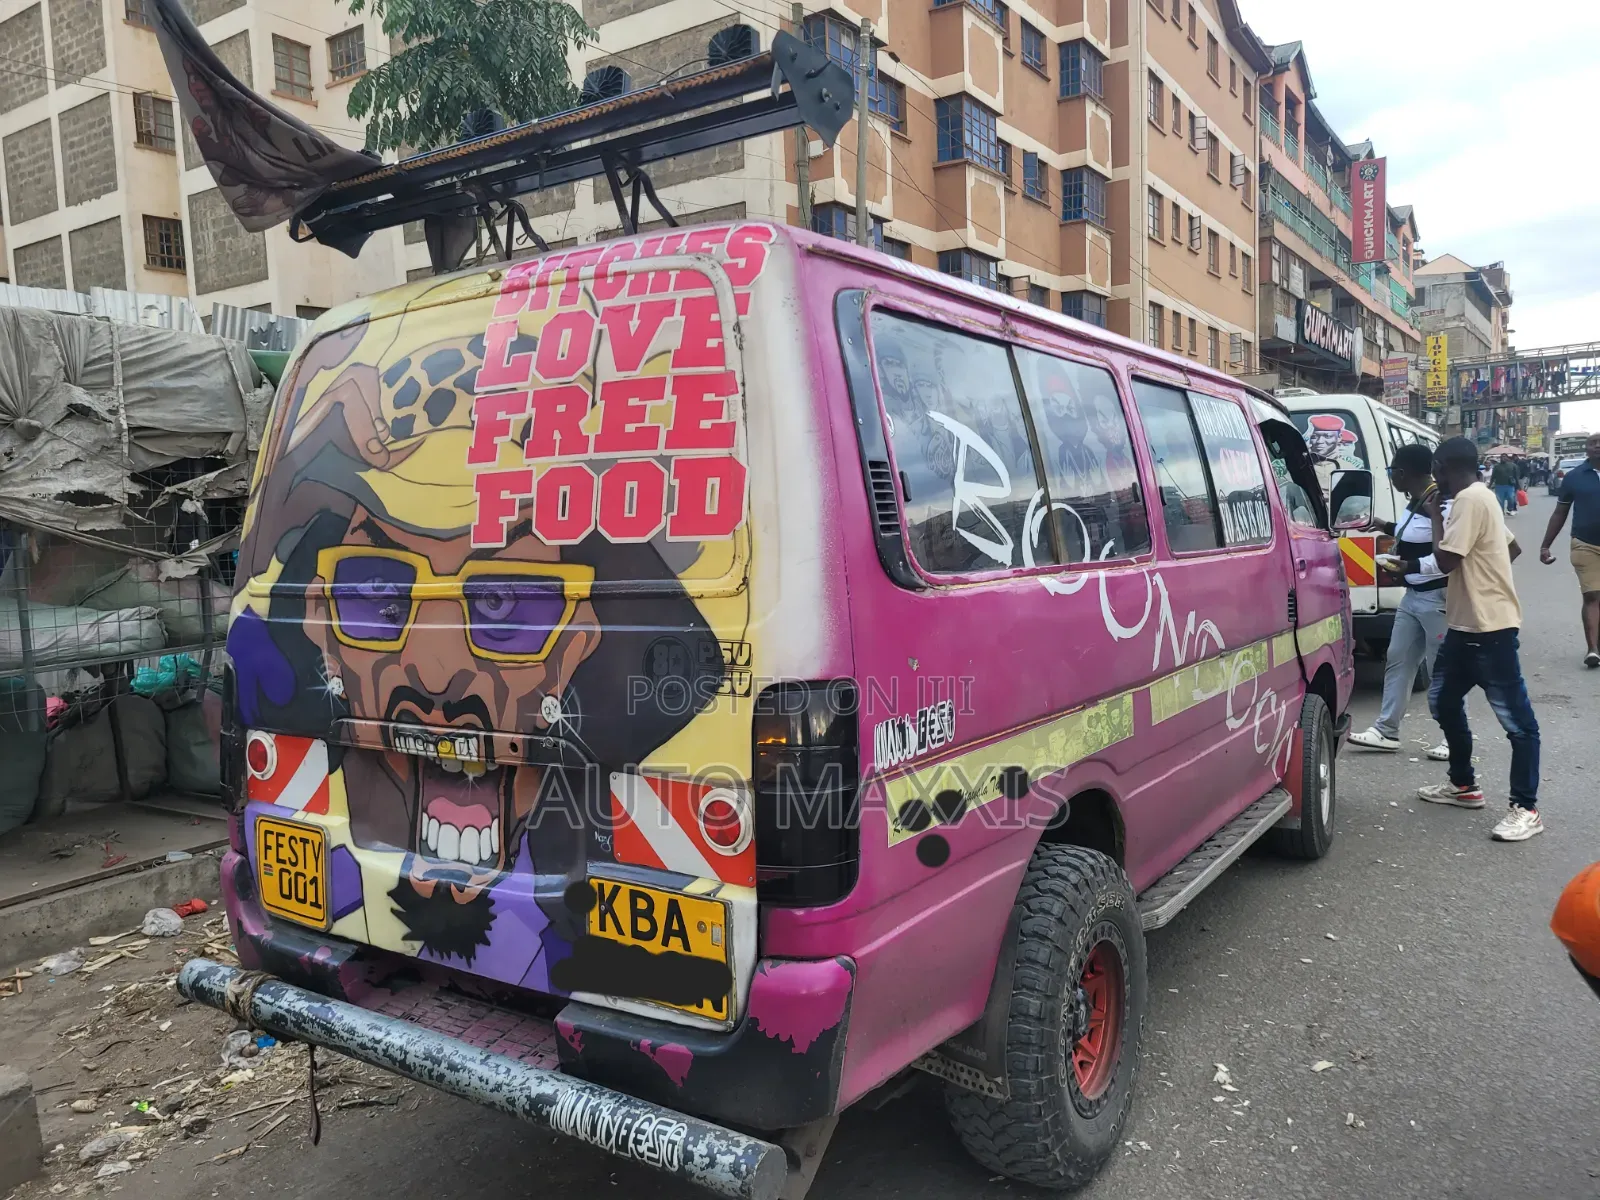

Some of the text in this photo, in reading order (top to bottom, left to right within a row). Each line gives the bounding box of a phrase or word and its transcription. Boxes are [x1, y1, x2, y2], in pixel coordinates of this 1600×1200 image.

[1364, 183, 1375, 260] QUICKMART
[474, 291, 752, 393] LOVE
[1304, 305, 1353, 361] QUICKMART
[1432, 336, 1442, 386] TOP GEAR
[466, 370, 739, 469] FREE
[471, 456, 749, 548] FOOD
[263, 829, 323, 873] FESTY
[279, 867, 323, 910] 001
[597, 882, 692, 953] KBA
